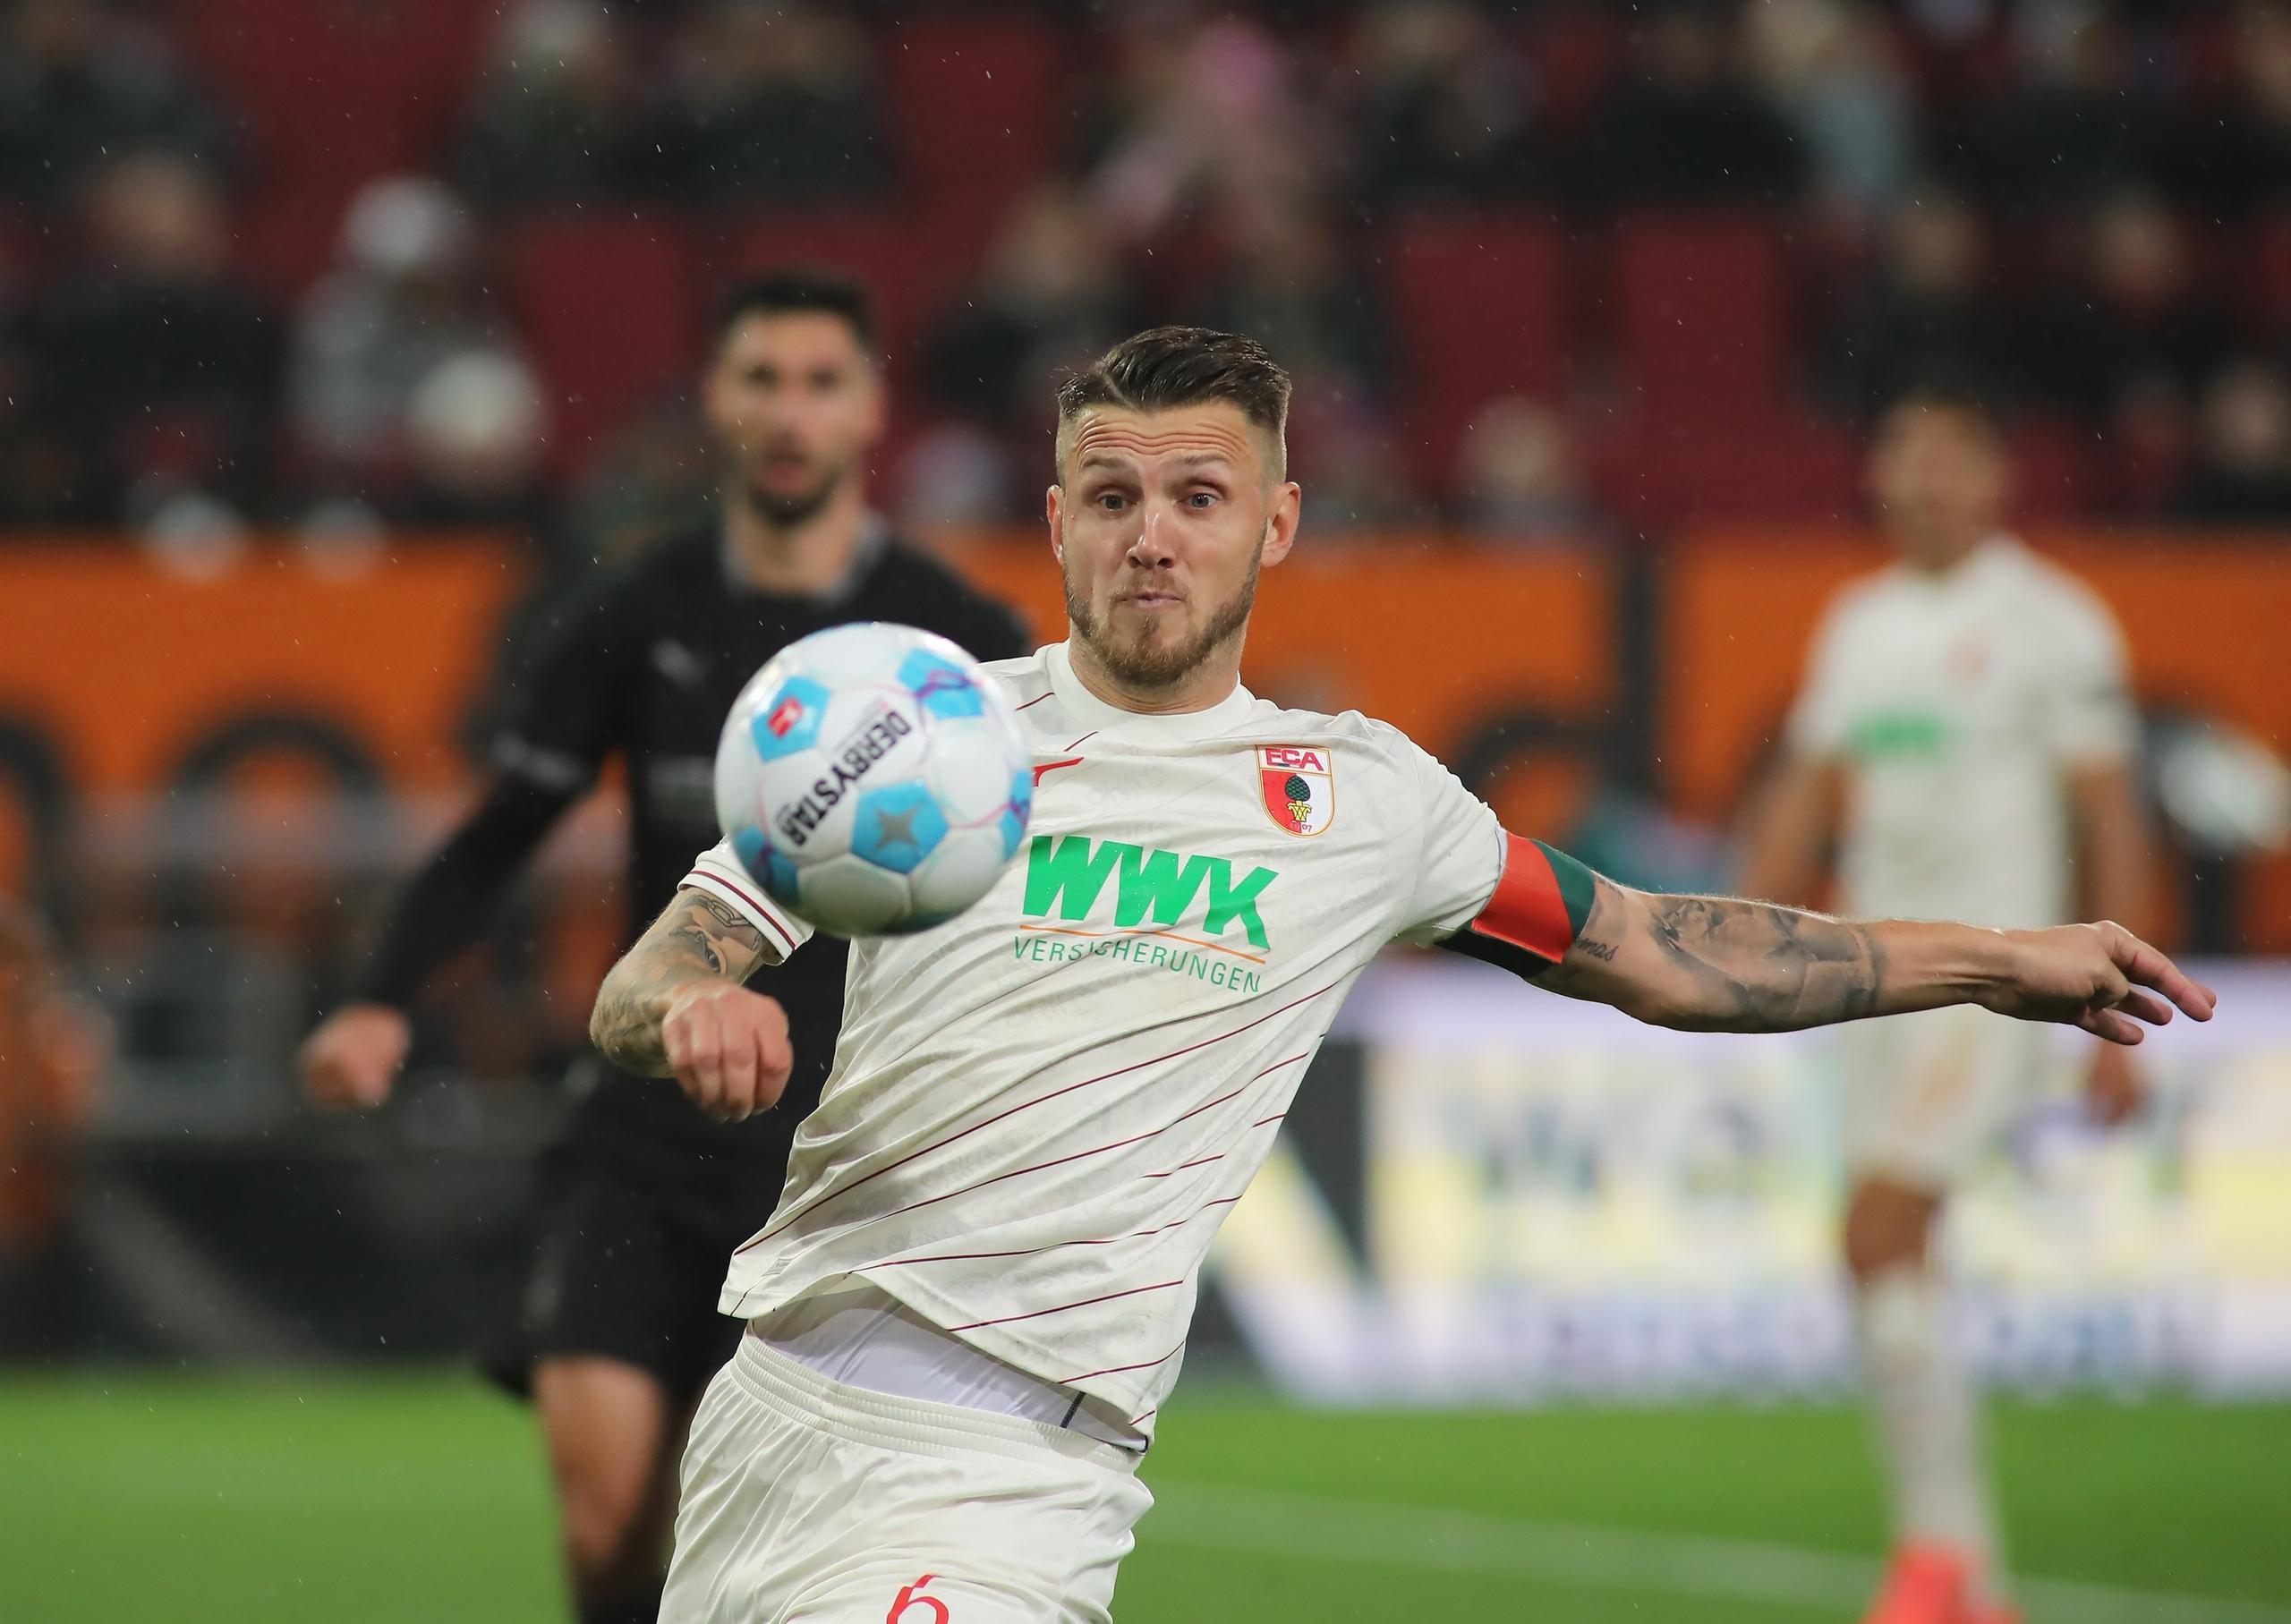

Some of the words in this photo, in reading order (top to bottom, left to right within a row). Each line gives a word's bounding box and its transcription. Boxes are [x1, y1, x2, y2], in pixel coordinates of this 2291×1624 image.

[780, 710, 911, 846] DERBYSTAR
[1022, 835, 1279, 951] WWK
[1014, 936, 1261, 994] VERSICHERUNGEN
[886, 1574, 950, 1624] 6
